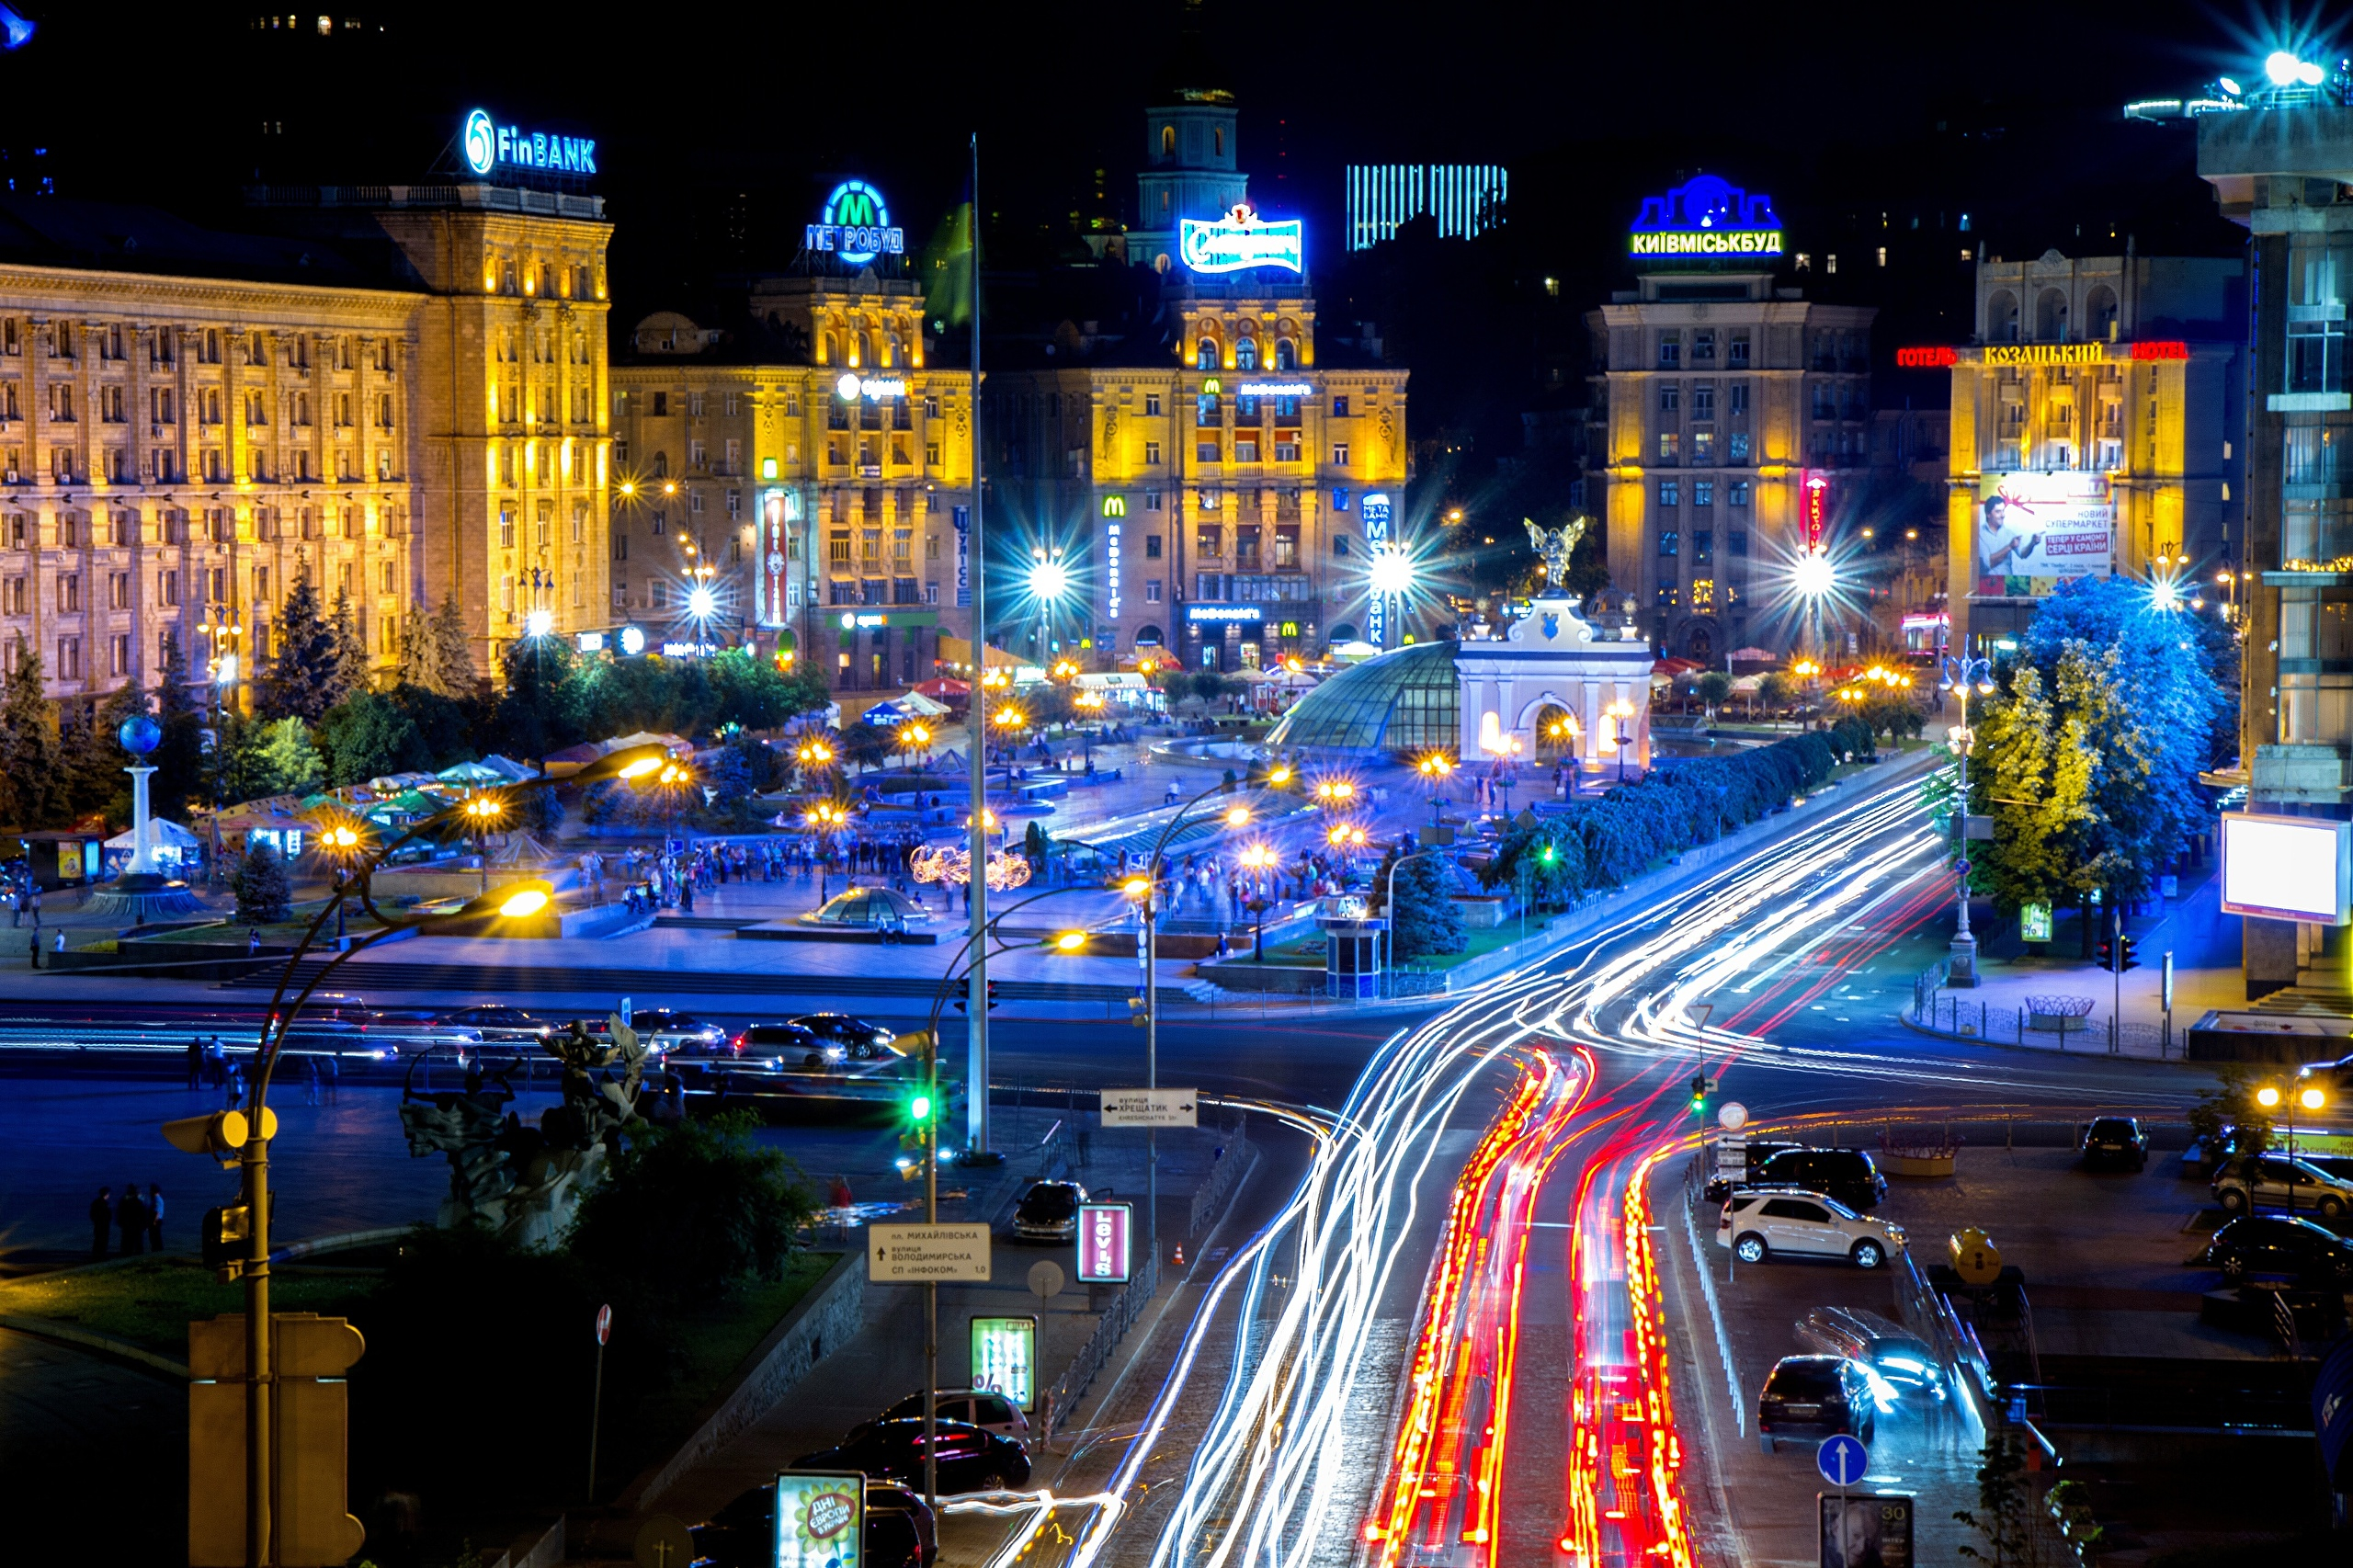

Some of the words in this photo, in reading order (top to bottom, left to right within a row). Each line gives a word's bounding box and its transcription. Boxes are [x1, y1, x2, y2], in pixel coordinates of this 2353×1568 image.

[497, 125, 597, 174] FinBANK
[807, 224, 904, 254] МЕТРОБУД
[1632, 232, 1781, 254] КИЇВМІСЬКБУД
[1897, 347, 1957, 366] ГОТЕЛЬ
[1984, 341, 2104, 366] КОЗАЦЬКИЙ
[2131, 342, 2188, 360] HOTEL
[2077, 508, 2109, 518] НОВИЙ
[2045, 519, 2109, 528] СУПЕРМАРКЕТ
[2076, 534, 2107, 542] САМОМУ
[2047, 543, 2074, 554] СЕРЦІ
[2075, 541, 2107, 551] КРАЇНИ
[1119, 1104, 1168, 1112] ХРЕЩАТИК
[906, 1231, 978, 1240] МИХАЙЛІВСЬКА
[892, 1253, 972, 1262] ВОЛОДИМИРСЬКА
[812, 1495, 836, 1516] ДНІ
[809, 1504, 850, 1528] ЄВРОПИ
[1881, 1506, 1906, 1520] 30
